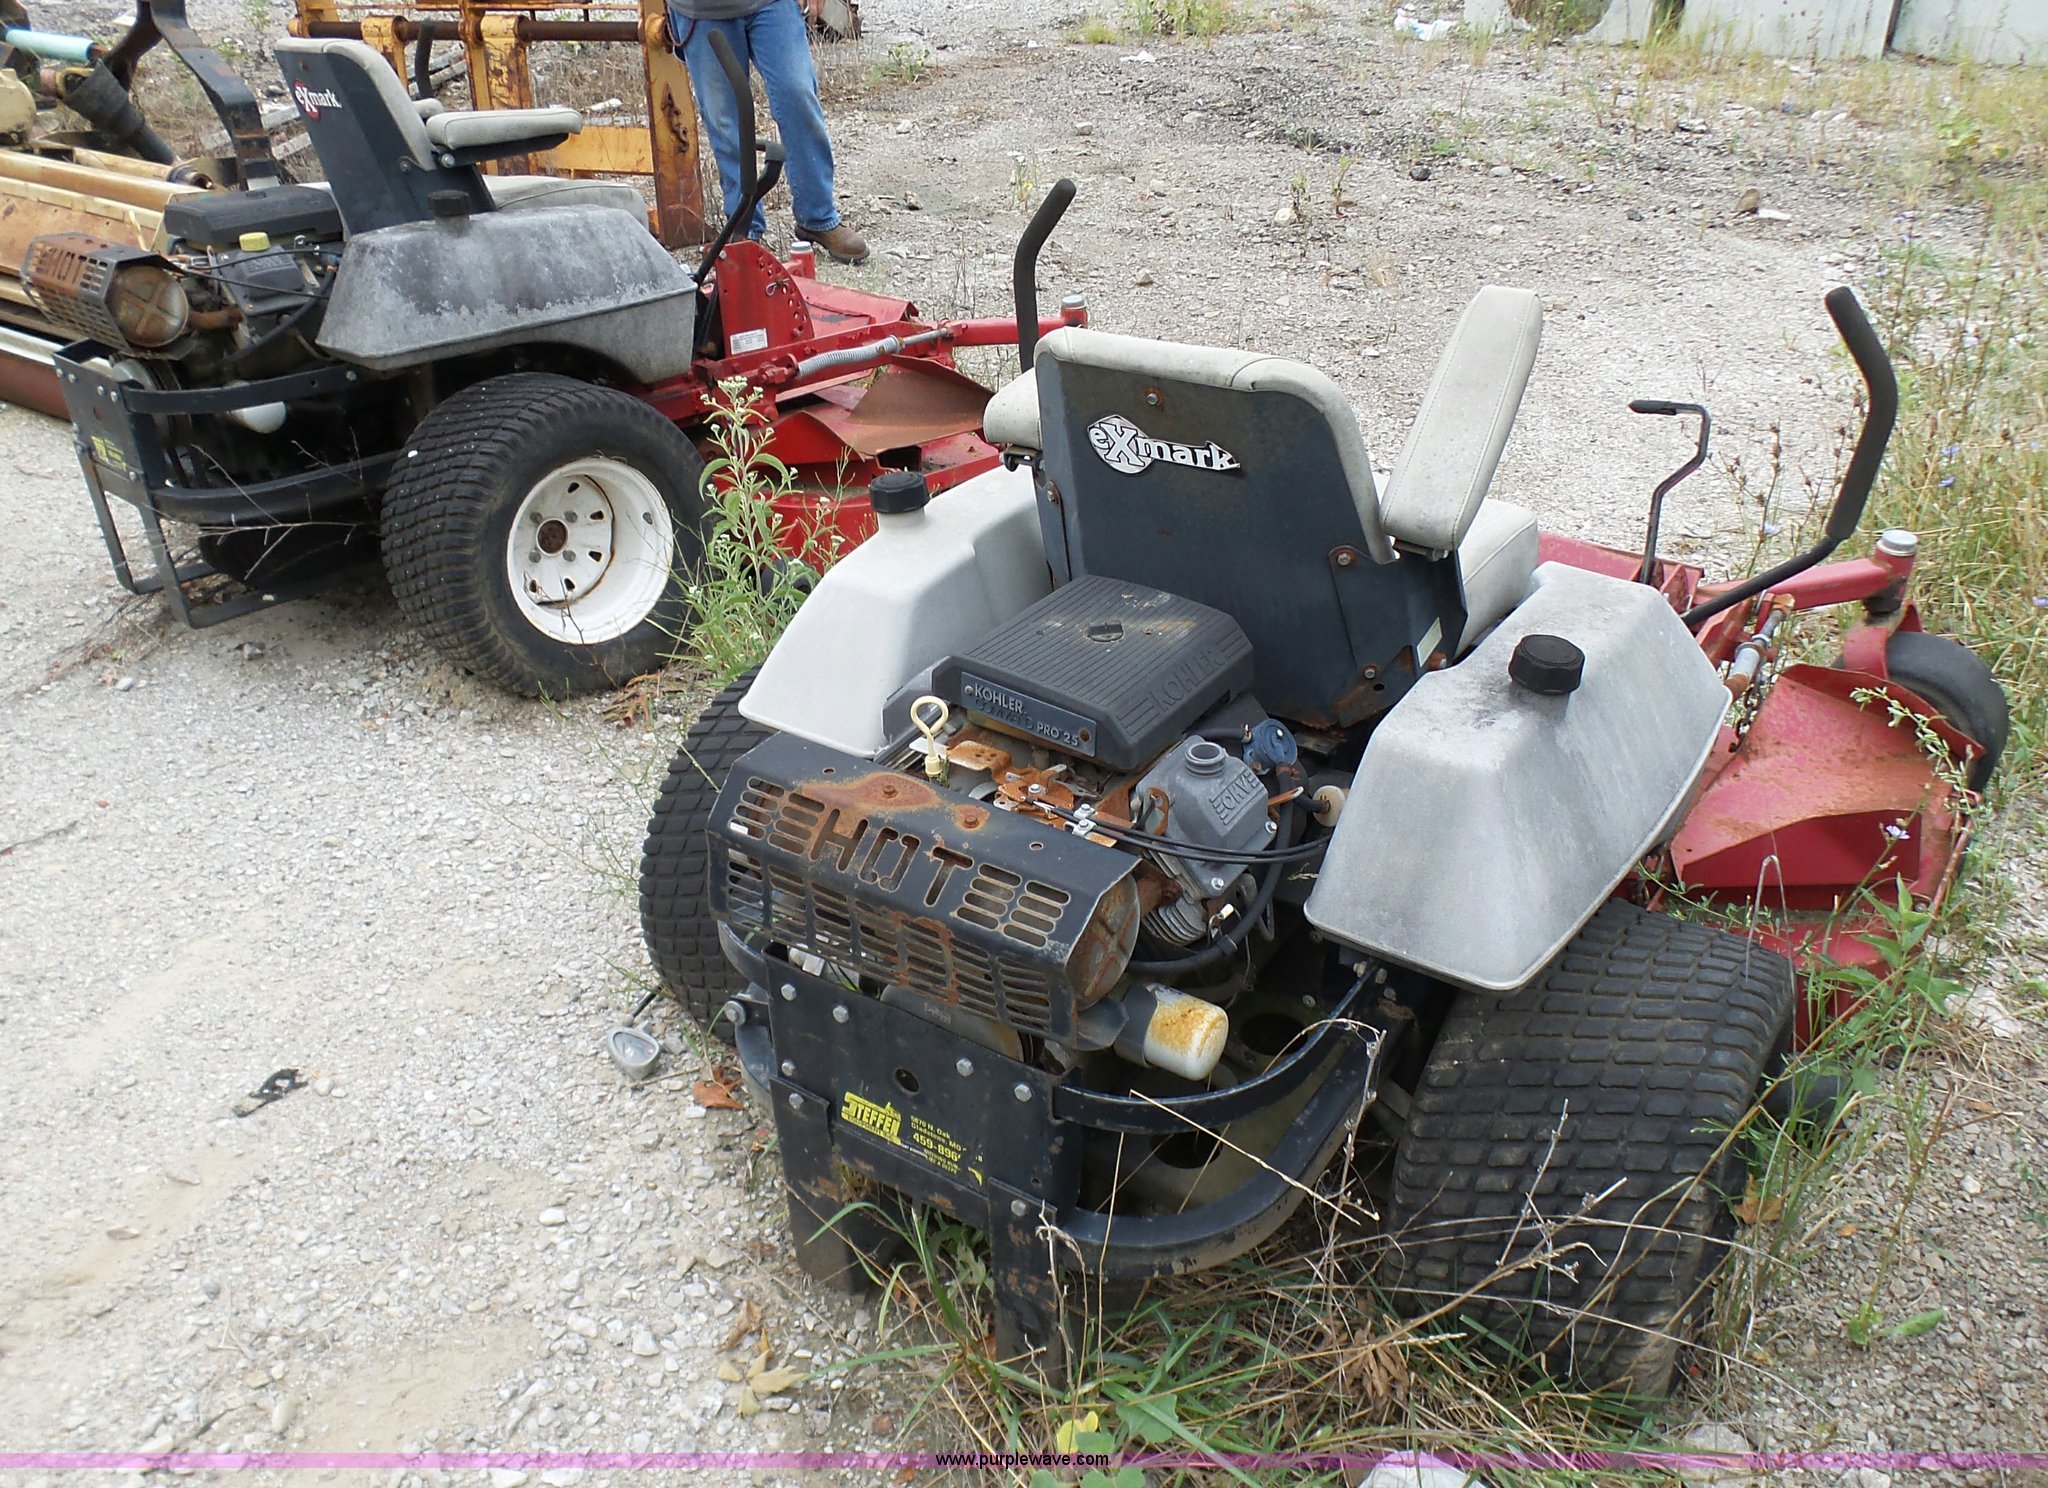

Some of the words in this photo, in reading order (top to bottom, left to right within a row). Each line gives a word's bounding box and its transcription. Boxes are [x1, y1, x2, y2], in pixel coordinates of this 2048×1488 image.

[974, 683, 1024, 713] KOHLER
[1037, 722, 1060, 740] PRO
[1063, 731, 1080, 747] 25
[807, 808, 974, 907] HOT
[841, 1091, 901, 1138] STEFFEN
[936, 1128, 951, 1140] Oak
[949, 1140, 962, 1152] MO
